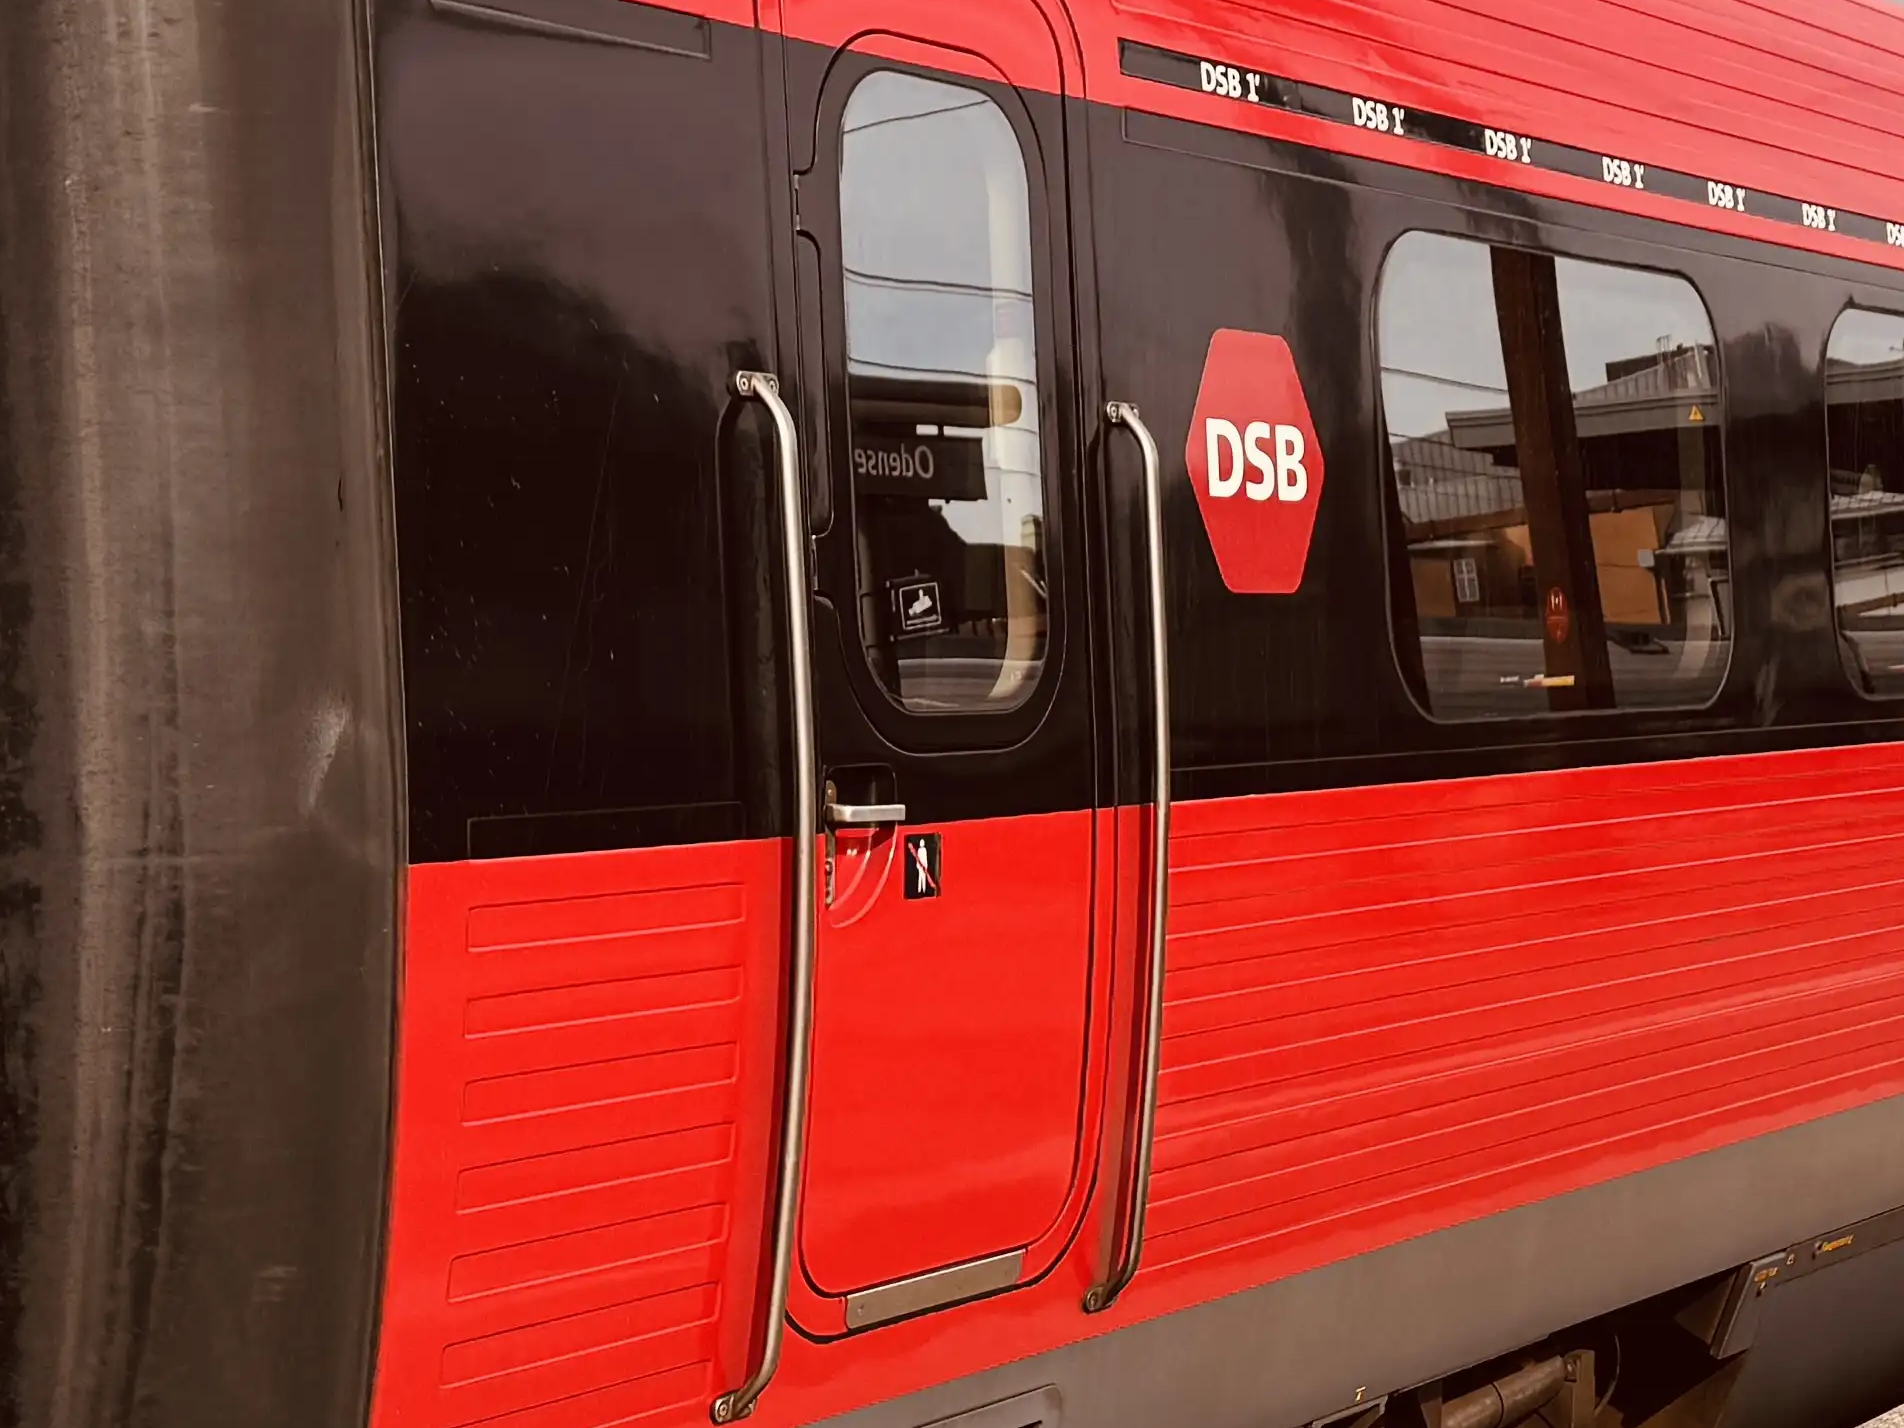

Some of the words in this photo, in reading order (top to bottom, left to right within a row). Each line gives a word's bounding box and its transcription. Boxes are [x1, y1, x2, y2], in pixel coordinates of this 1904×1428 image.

[1201, 62, 1242, 98] DSB
[1353, 98, 1389, 131] DSB
[1484, 129, 1517, 160] DSB
[1602, 157, 1631, 186] DSB
[1707, 182, 1734, 209] DSB
[1802, 203, 1826, 229] DSB
[1205, 417, 1308, 502] DSB
